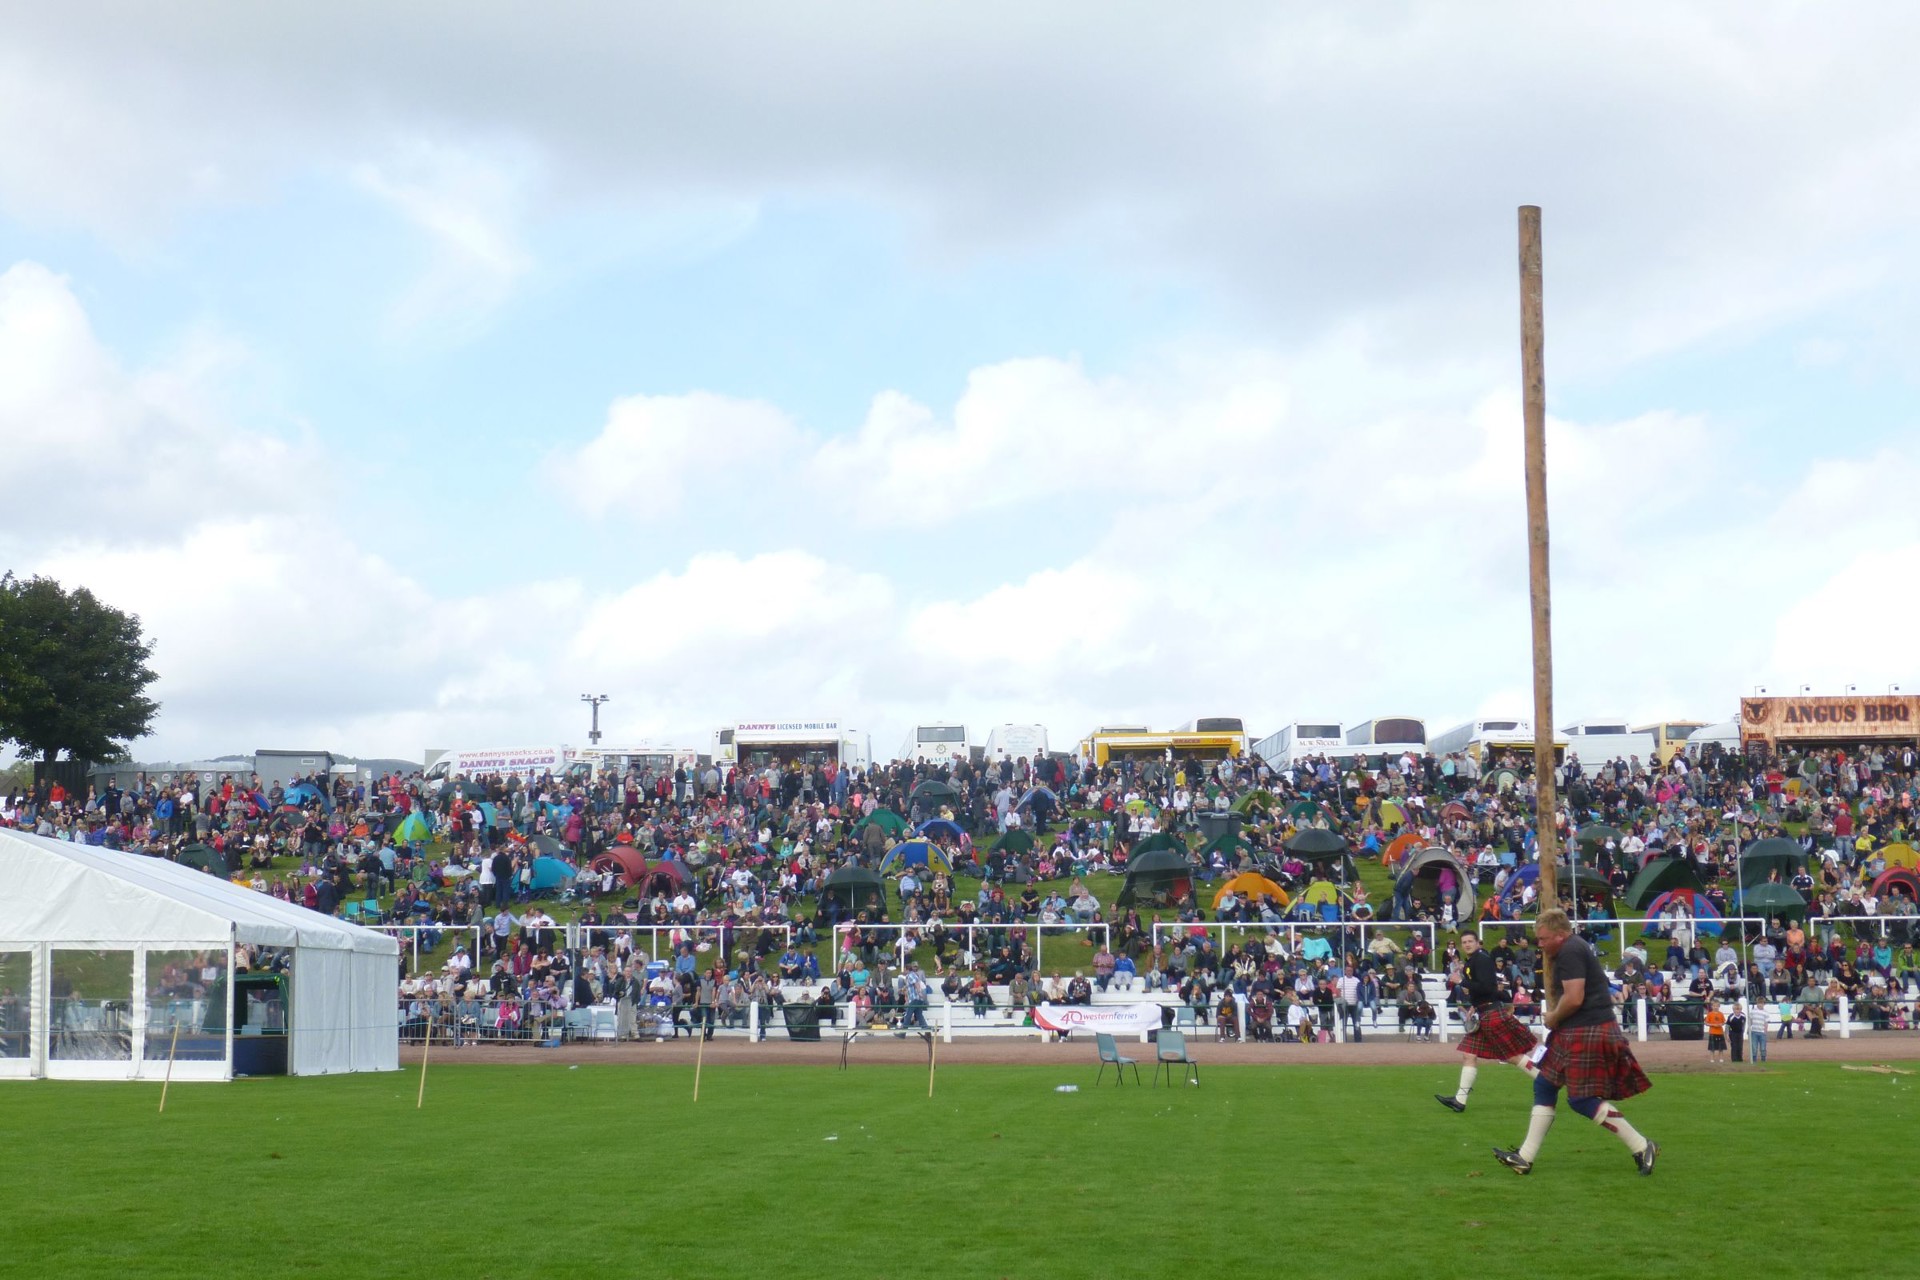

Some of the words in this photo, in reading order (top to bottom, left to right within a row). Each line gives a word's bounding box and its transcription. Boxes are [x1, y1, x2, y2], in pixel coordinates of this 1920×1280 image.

[1783, 705, 1857, 723] ANGUS
[1864, 704, 1910, 722] BBQ
[459, 749, 554, 759] www.dannyssnacks.co.uk
[459, 759, 505, 768] DANNYS
[510, 756, 556, 766] SNACKS
